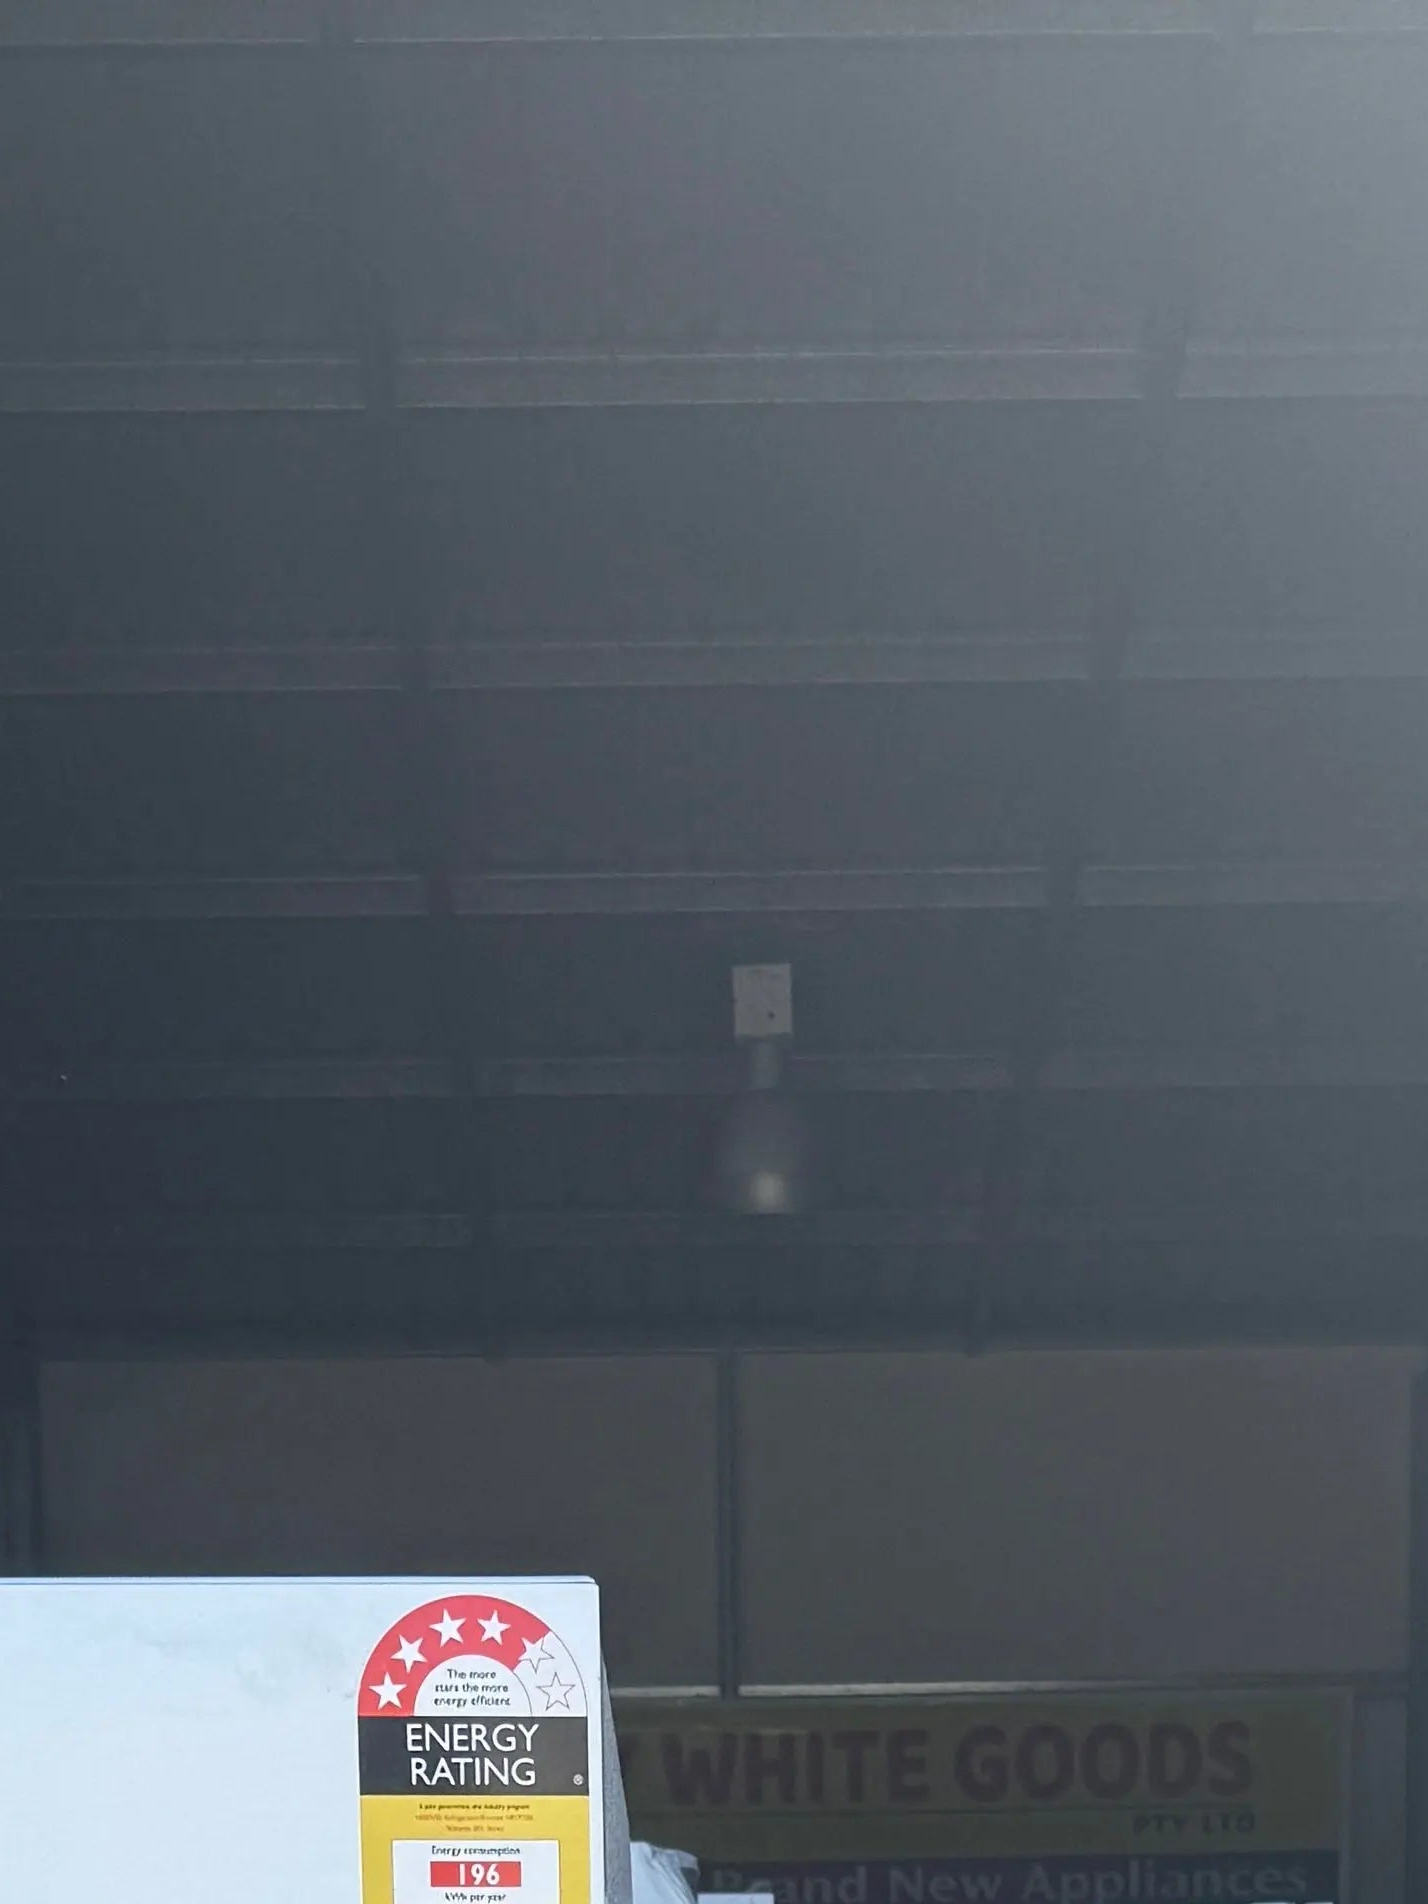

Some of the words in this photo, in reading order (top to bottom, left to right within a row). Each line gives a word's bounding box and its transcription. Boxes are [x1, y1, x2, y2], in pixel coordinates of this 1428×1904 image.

[406, 1723, 539, 1752] ENERGY
[411, 1757, 536, 1786] RATING
[661, 1727, 930, 1807] WHITE
[953, 1719, 1254, 1803] GOODS
[1133, 1811, 1190, 1835] PTY
[1202, 1810, 1256, 1833] LTD
[458, 1863, 501, 1886] 196
